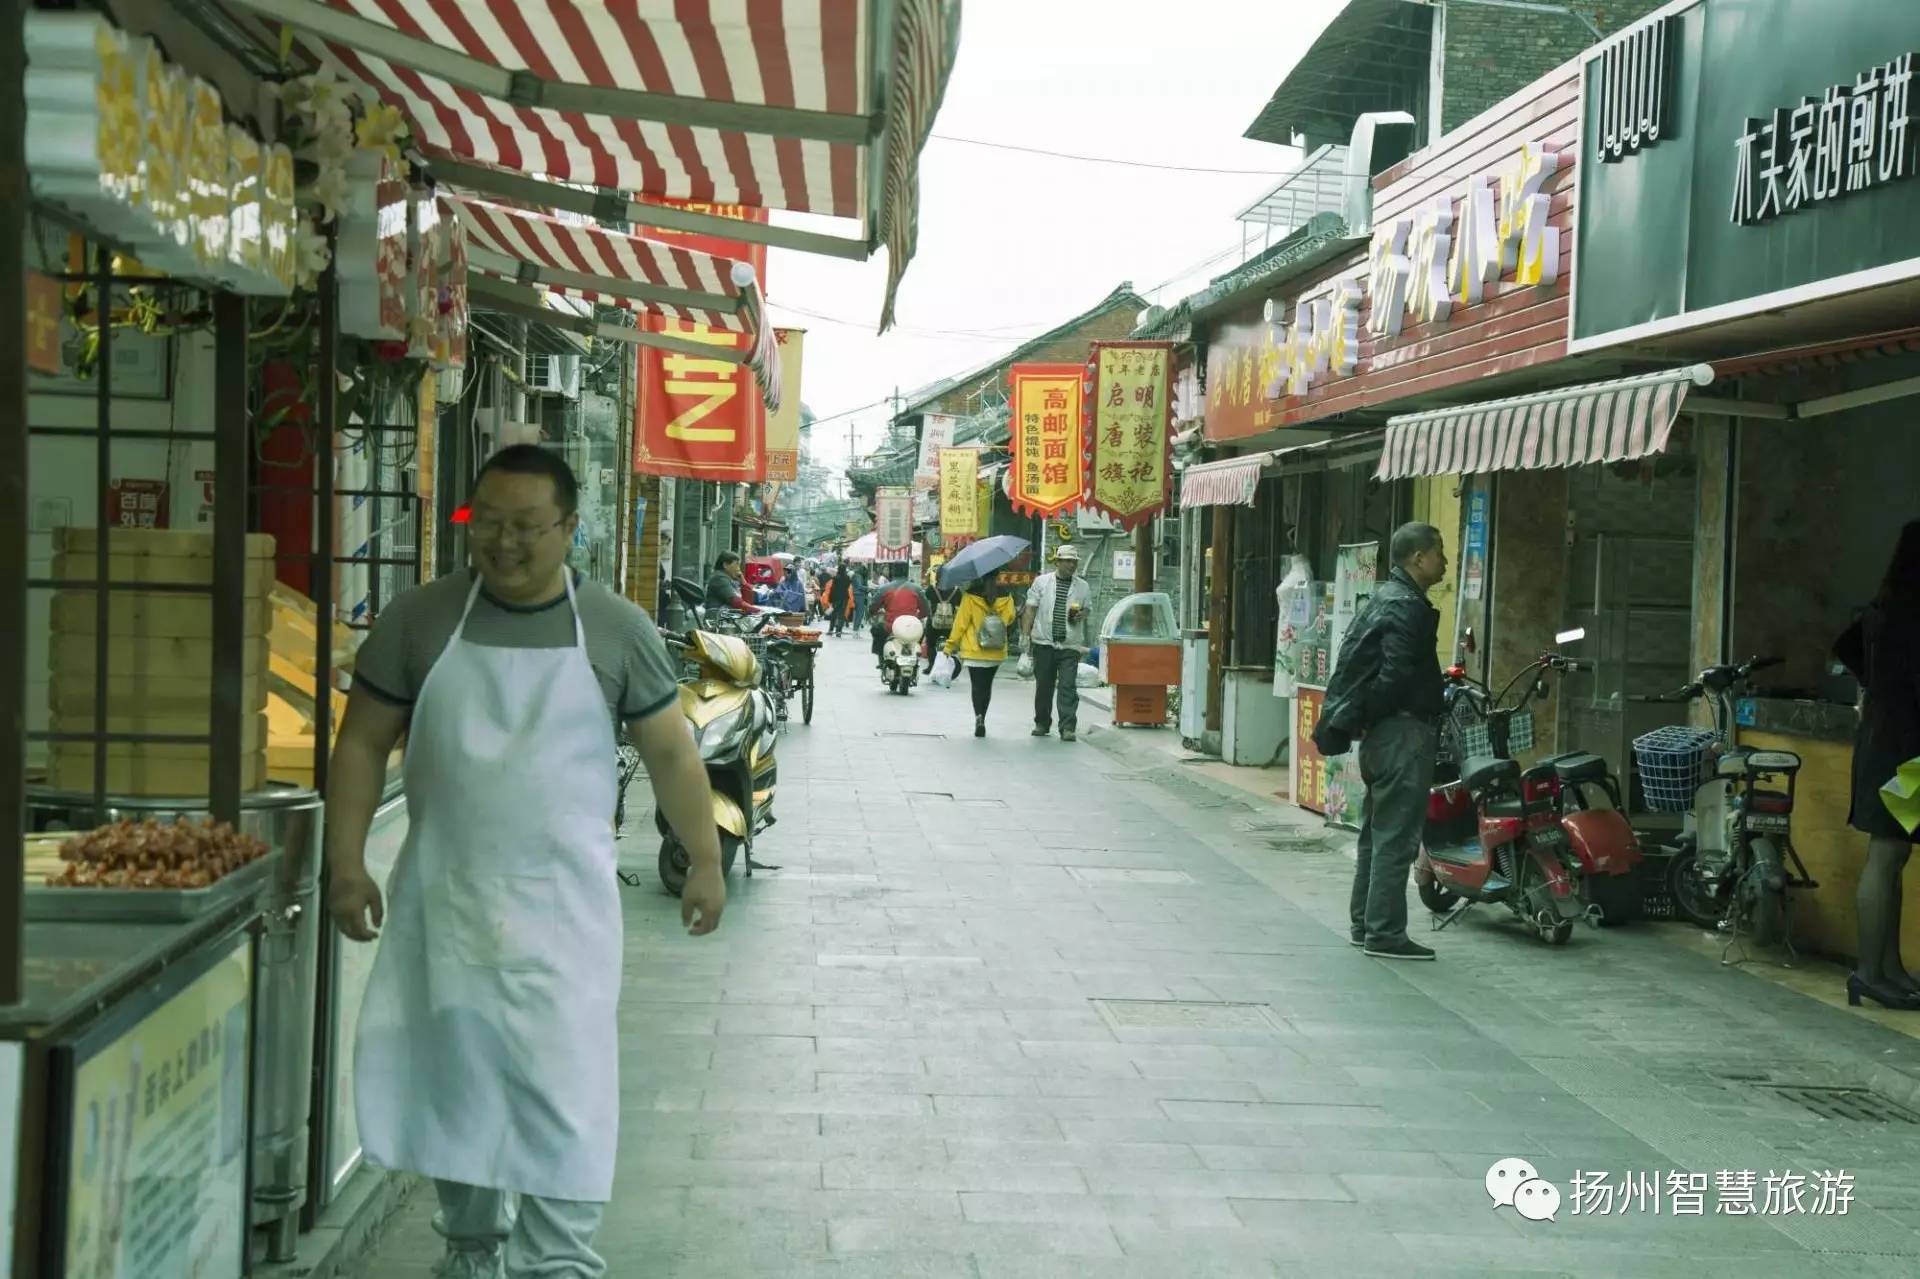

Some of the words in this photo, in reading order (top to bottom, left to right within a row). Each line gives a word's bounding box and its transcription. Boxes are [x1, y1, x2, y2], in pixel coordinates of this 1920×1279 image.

[1730, 52, 1913, 226] 木头家的煎饼
[1106, 382, 1156, 408] 启明
[1025, 413, 1040, 458] 特色馄饨
[1042, 388, 1069, 485] 高邮面馆
[1101, 422, 1157, 449] 唐装
[1025, 461, 1040, 495] 鱼汤面
[1099, 461, 1157, 484] 旗袍
